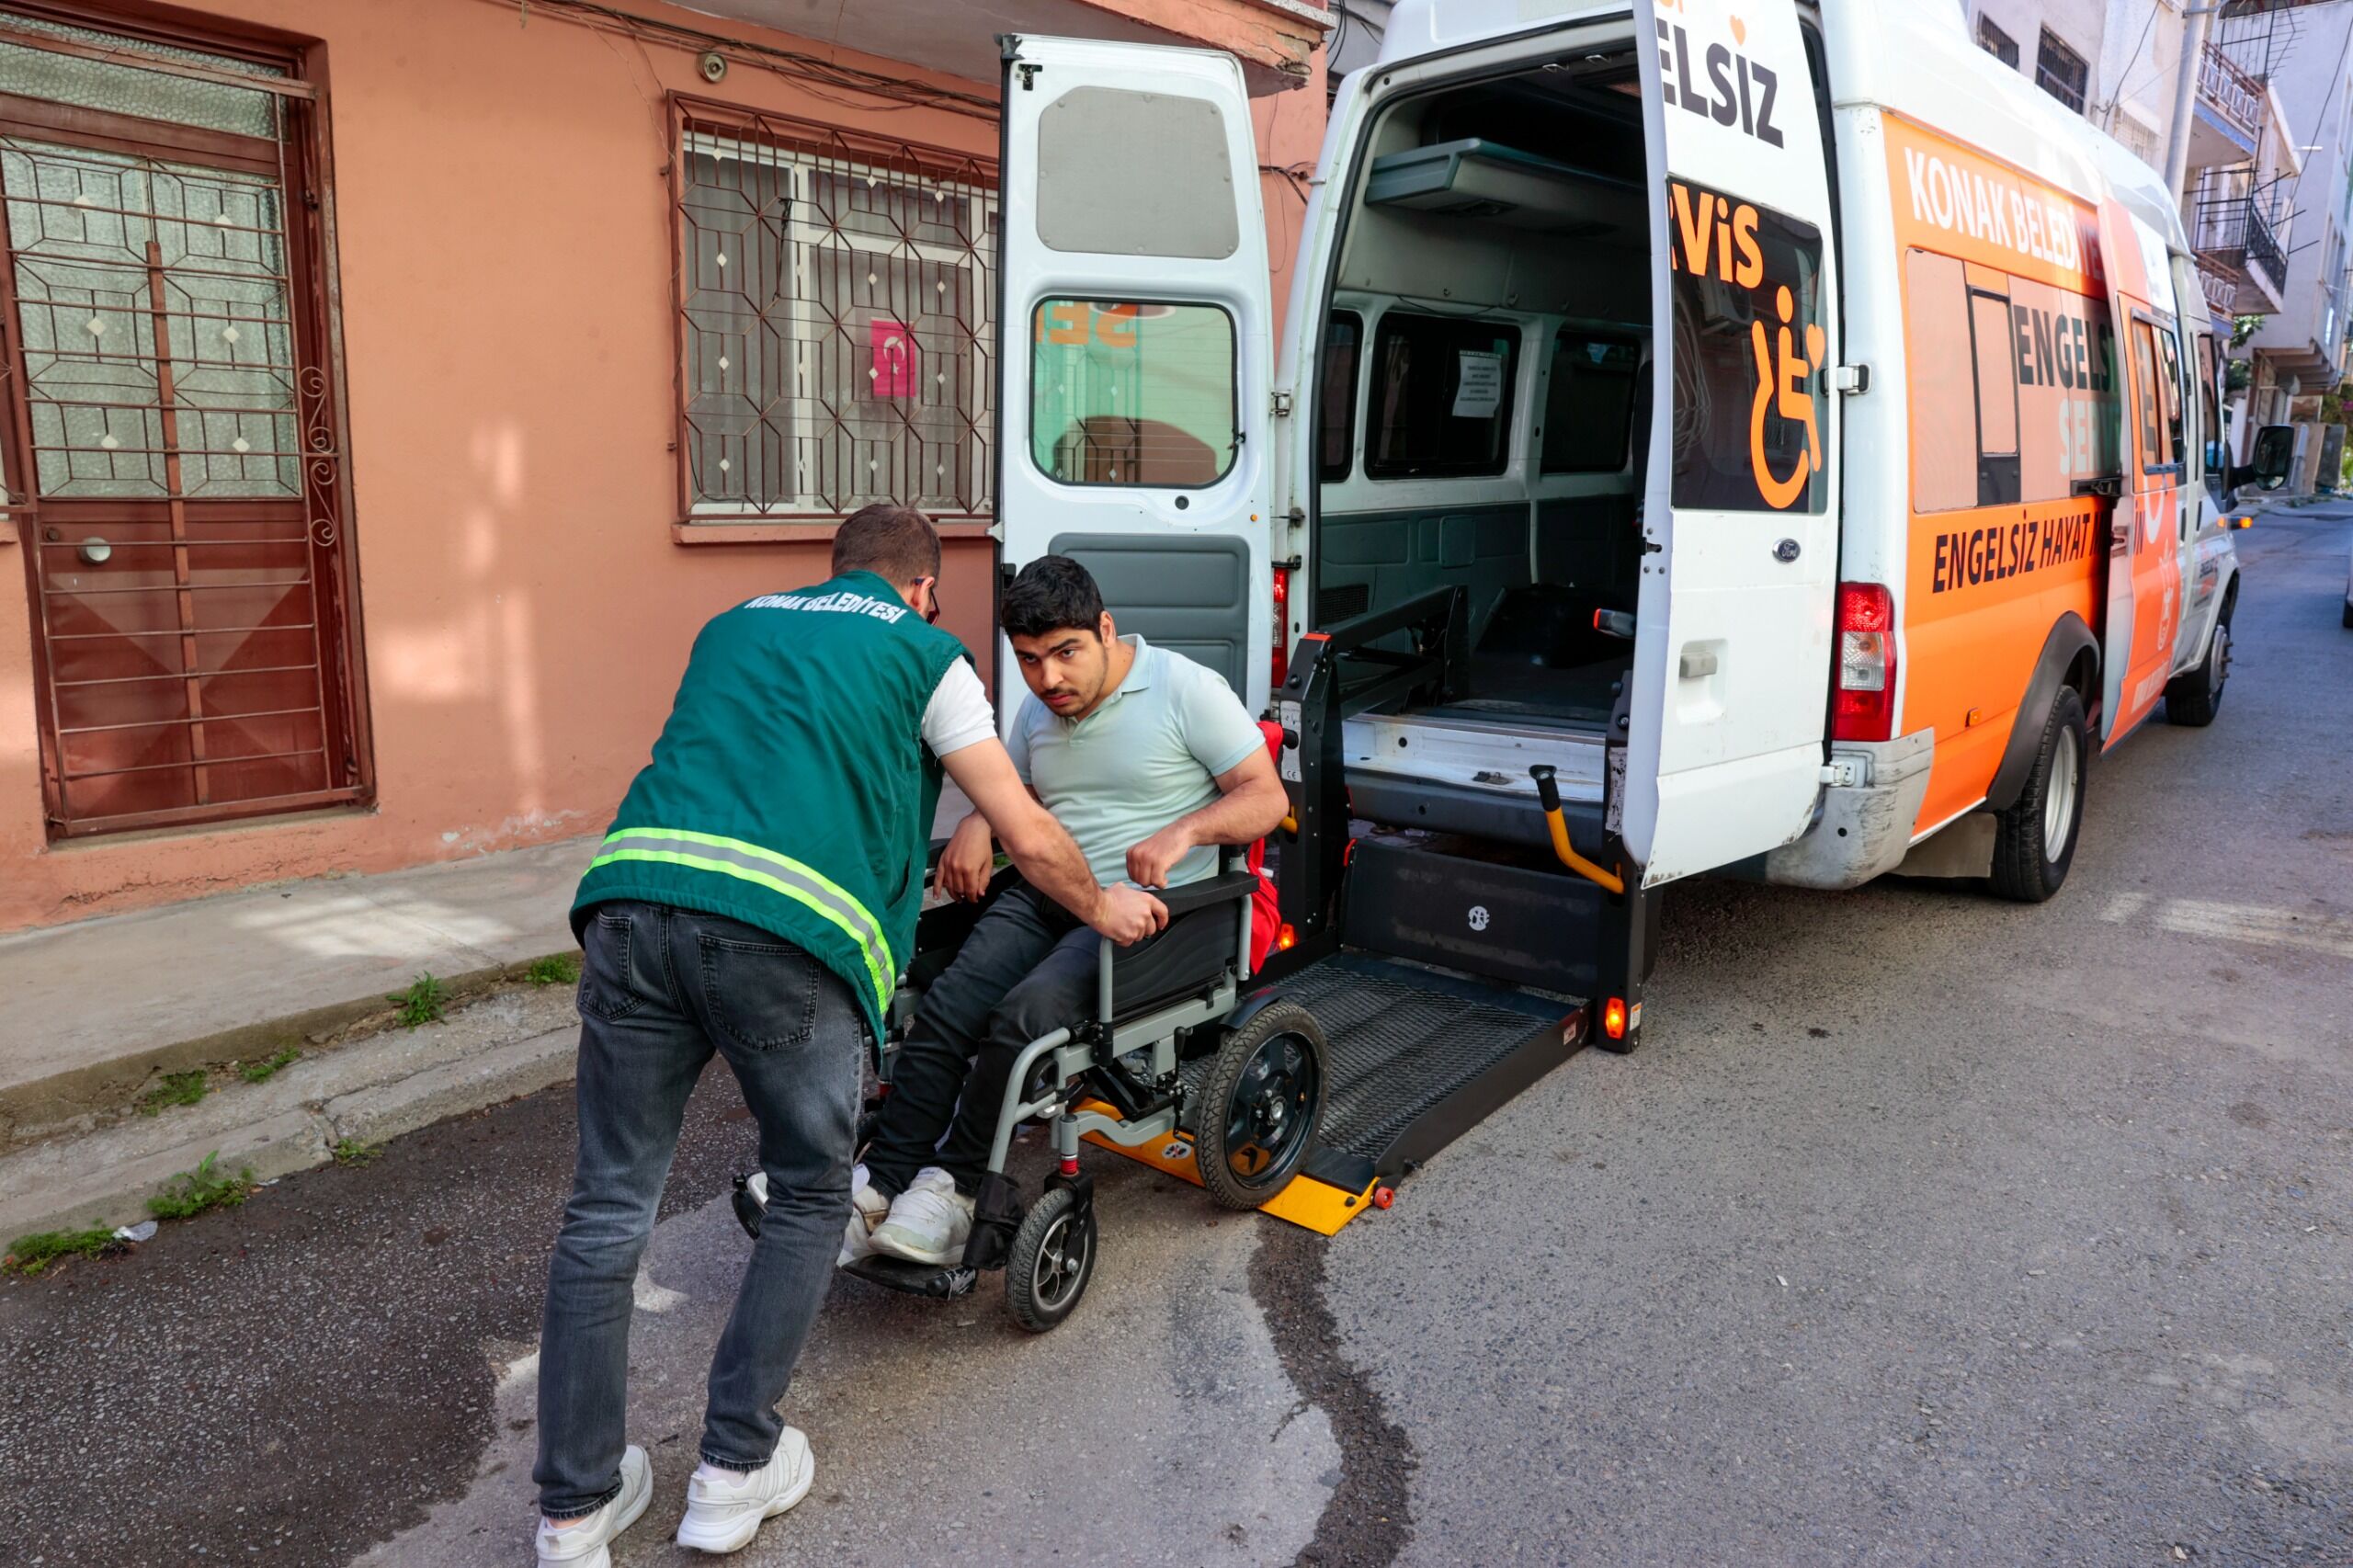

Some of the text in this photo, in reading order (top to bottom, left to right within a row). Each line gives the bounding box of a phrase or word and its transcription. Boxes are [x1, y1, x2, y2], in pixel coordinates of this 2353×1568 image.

[1904, 146, 2013, 249] KONAK
[1932, 509, 2038, 594] ENGELSİZ
[2040, 513, 2091, 569] HAYAT
[744, 595, 813, 610] KONAK
